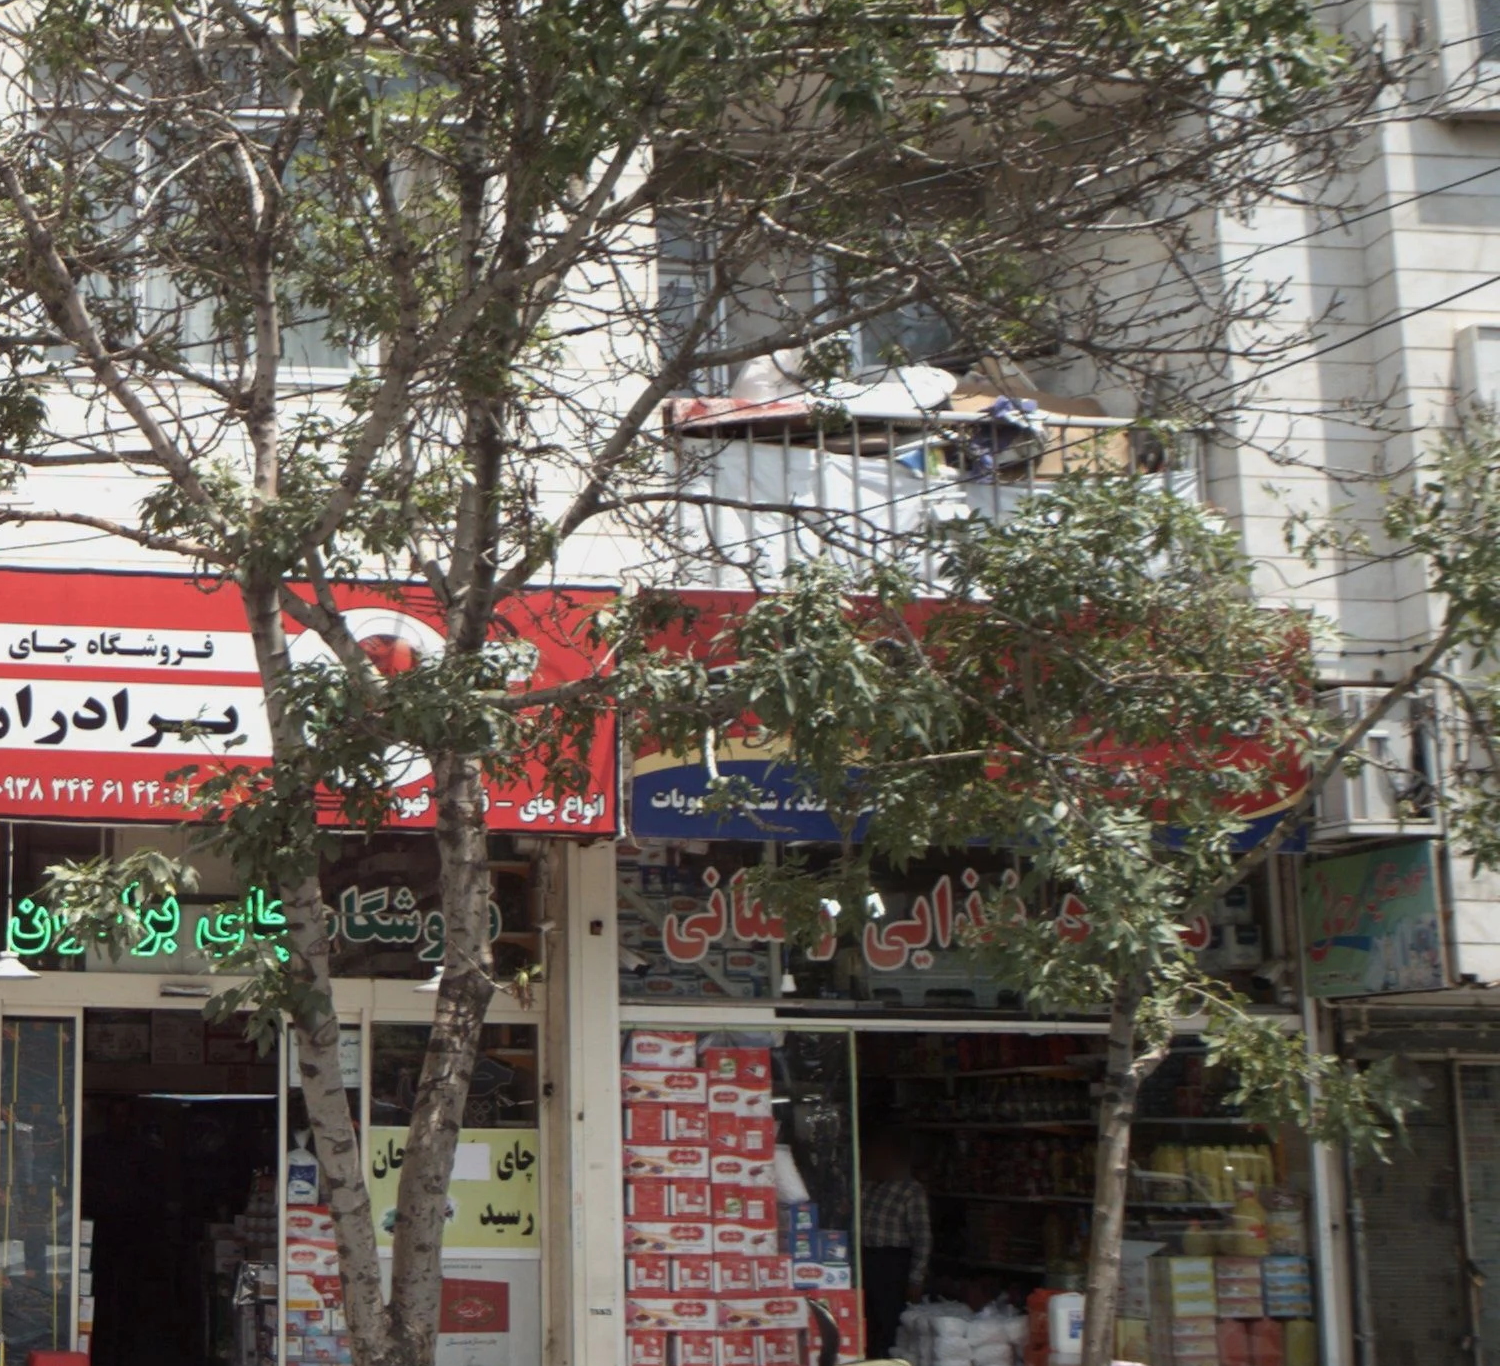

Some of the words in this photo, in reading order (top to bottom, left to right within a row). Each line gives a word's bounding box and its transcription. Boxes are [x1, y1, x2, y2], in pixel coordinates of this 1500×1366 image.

[8, 629, 77, 663] چای
[87, 631, 215, 666] فروشگاه
[518, 794, 558, 823] چای
[561, 794, 607, 824] انواع
[497, 1140, 536, 1182] چای
